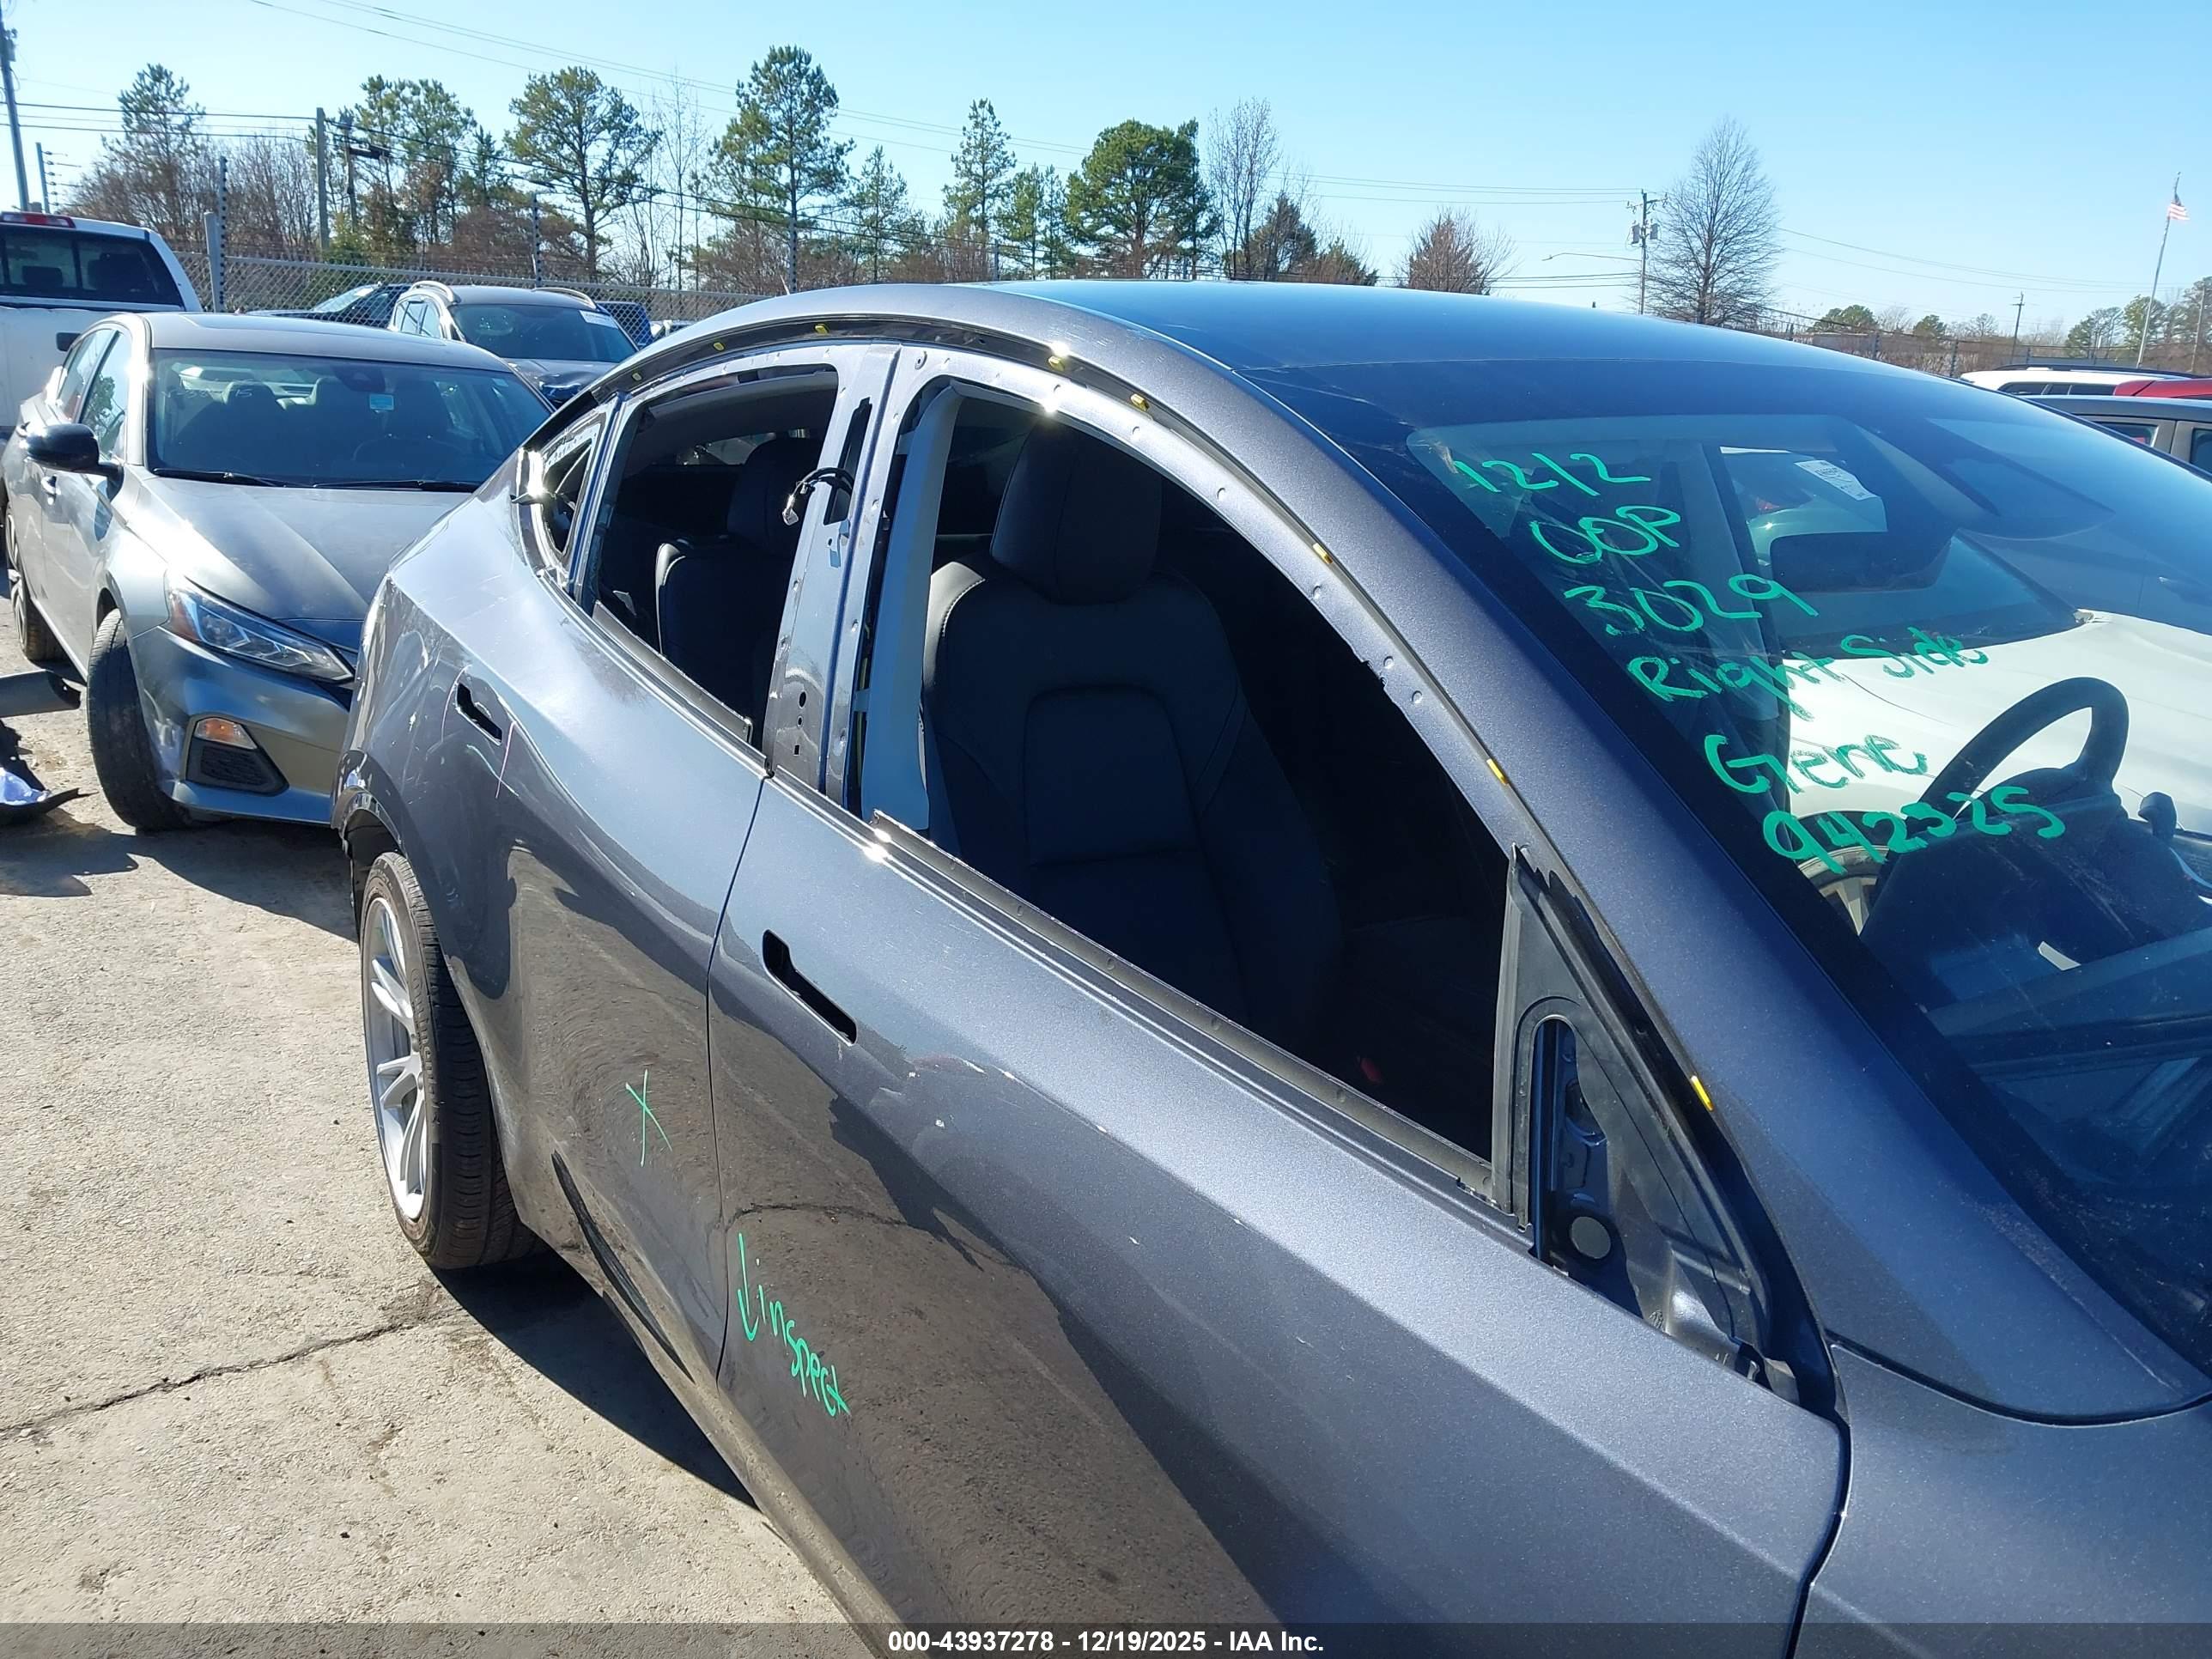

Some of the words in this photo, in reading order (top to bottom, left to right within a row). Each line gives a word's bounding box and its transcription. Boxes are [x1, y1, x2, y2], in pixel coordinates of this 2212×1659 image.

[1564, 574, 1819, 635] 3029
[1628, 651, 1845, 721] Right
[1840, 626, 1989, 678] Side
[1705, 734, 1928, 794] Gene
